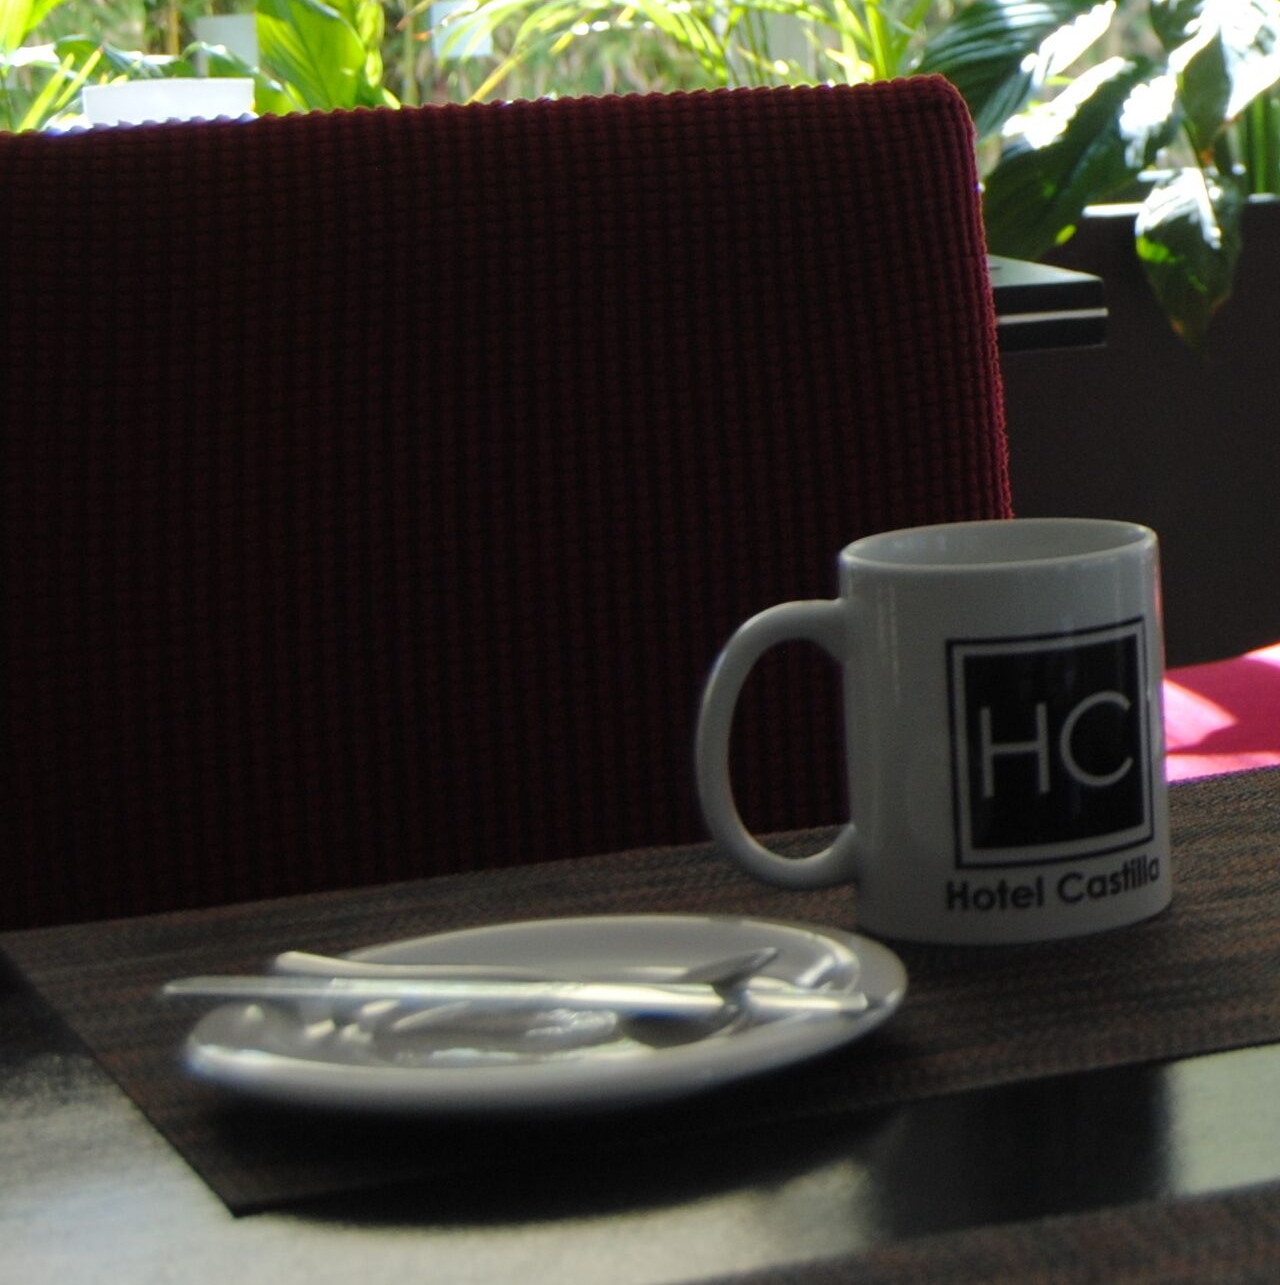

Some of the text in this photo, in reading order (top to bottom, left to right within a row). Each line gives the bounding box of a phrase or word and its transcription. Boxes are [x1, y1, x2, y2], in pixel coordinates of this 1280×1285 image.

[978, 690, 1134, 799] HC
[947, 854, 1161, 912] Hotel Castilla
